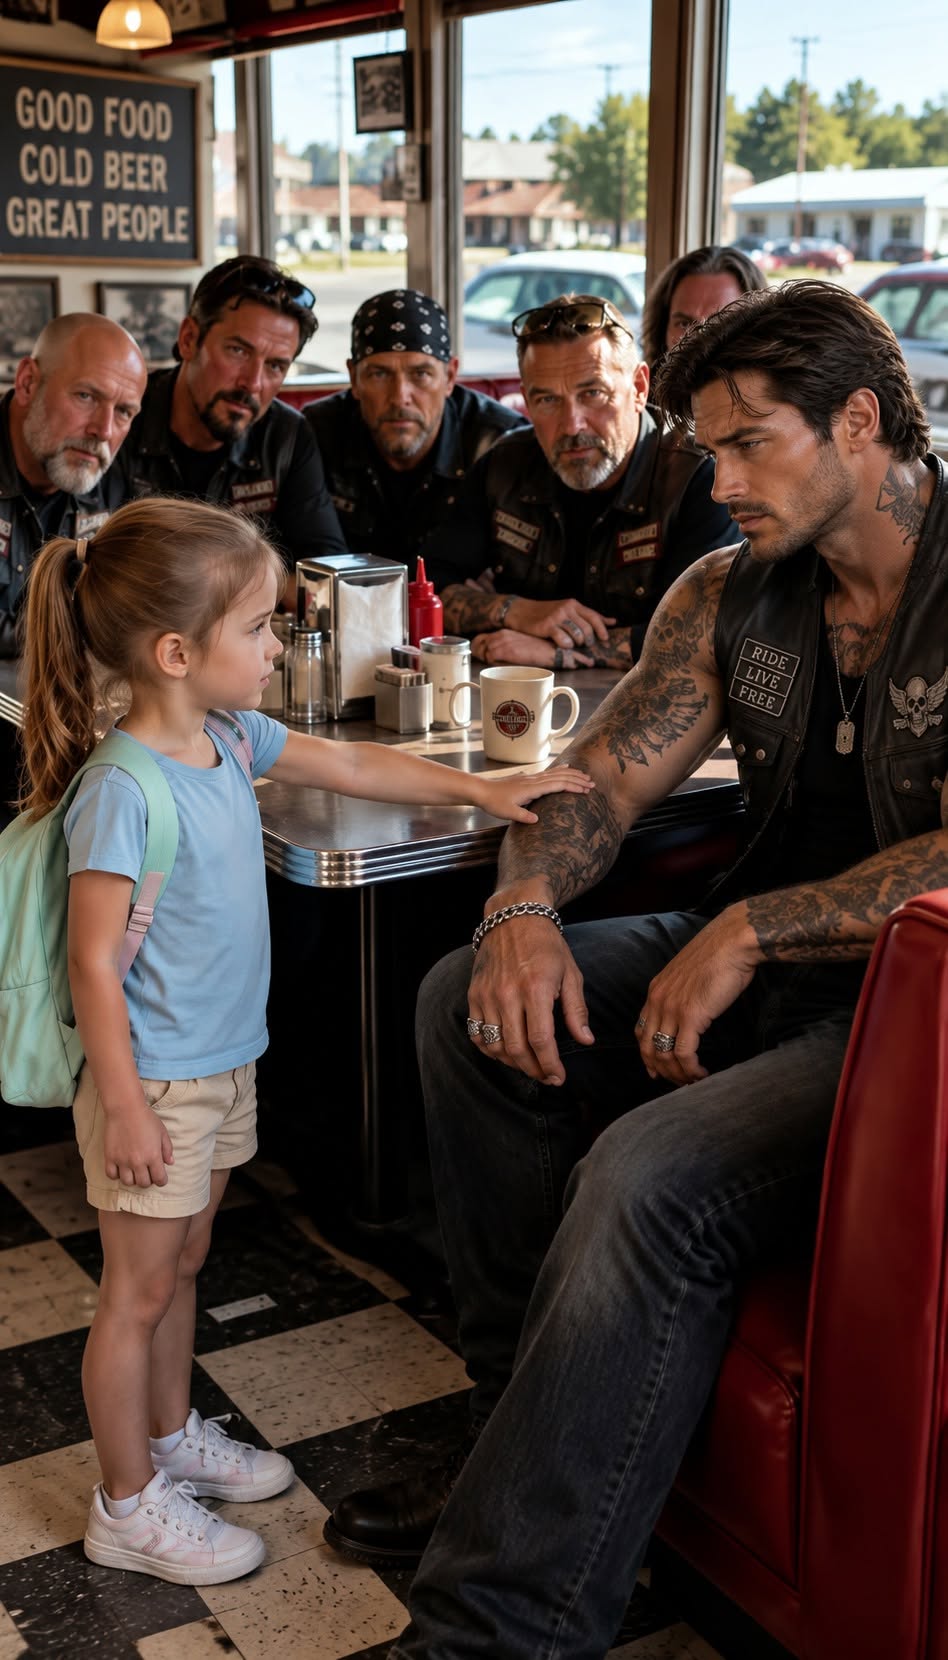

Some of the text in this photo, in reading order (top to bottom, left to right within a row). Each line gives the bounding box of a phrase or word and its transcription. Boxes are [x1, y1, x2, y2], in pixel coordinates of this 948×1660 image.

[16, 86, 172, 142] GOOD FOOD
[20, 143, 167, 192] COLD BEER
[6, 196, 189, 243] GREAT PEOPLE
[751, 646, 789, 670] RIDE
[745, 666, 781, 689] LIVE
[739, 685, 776, 709] FREE
